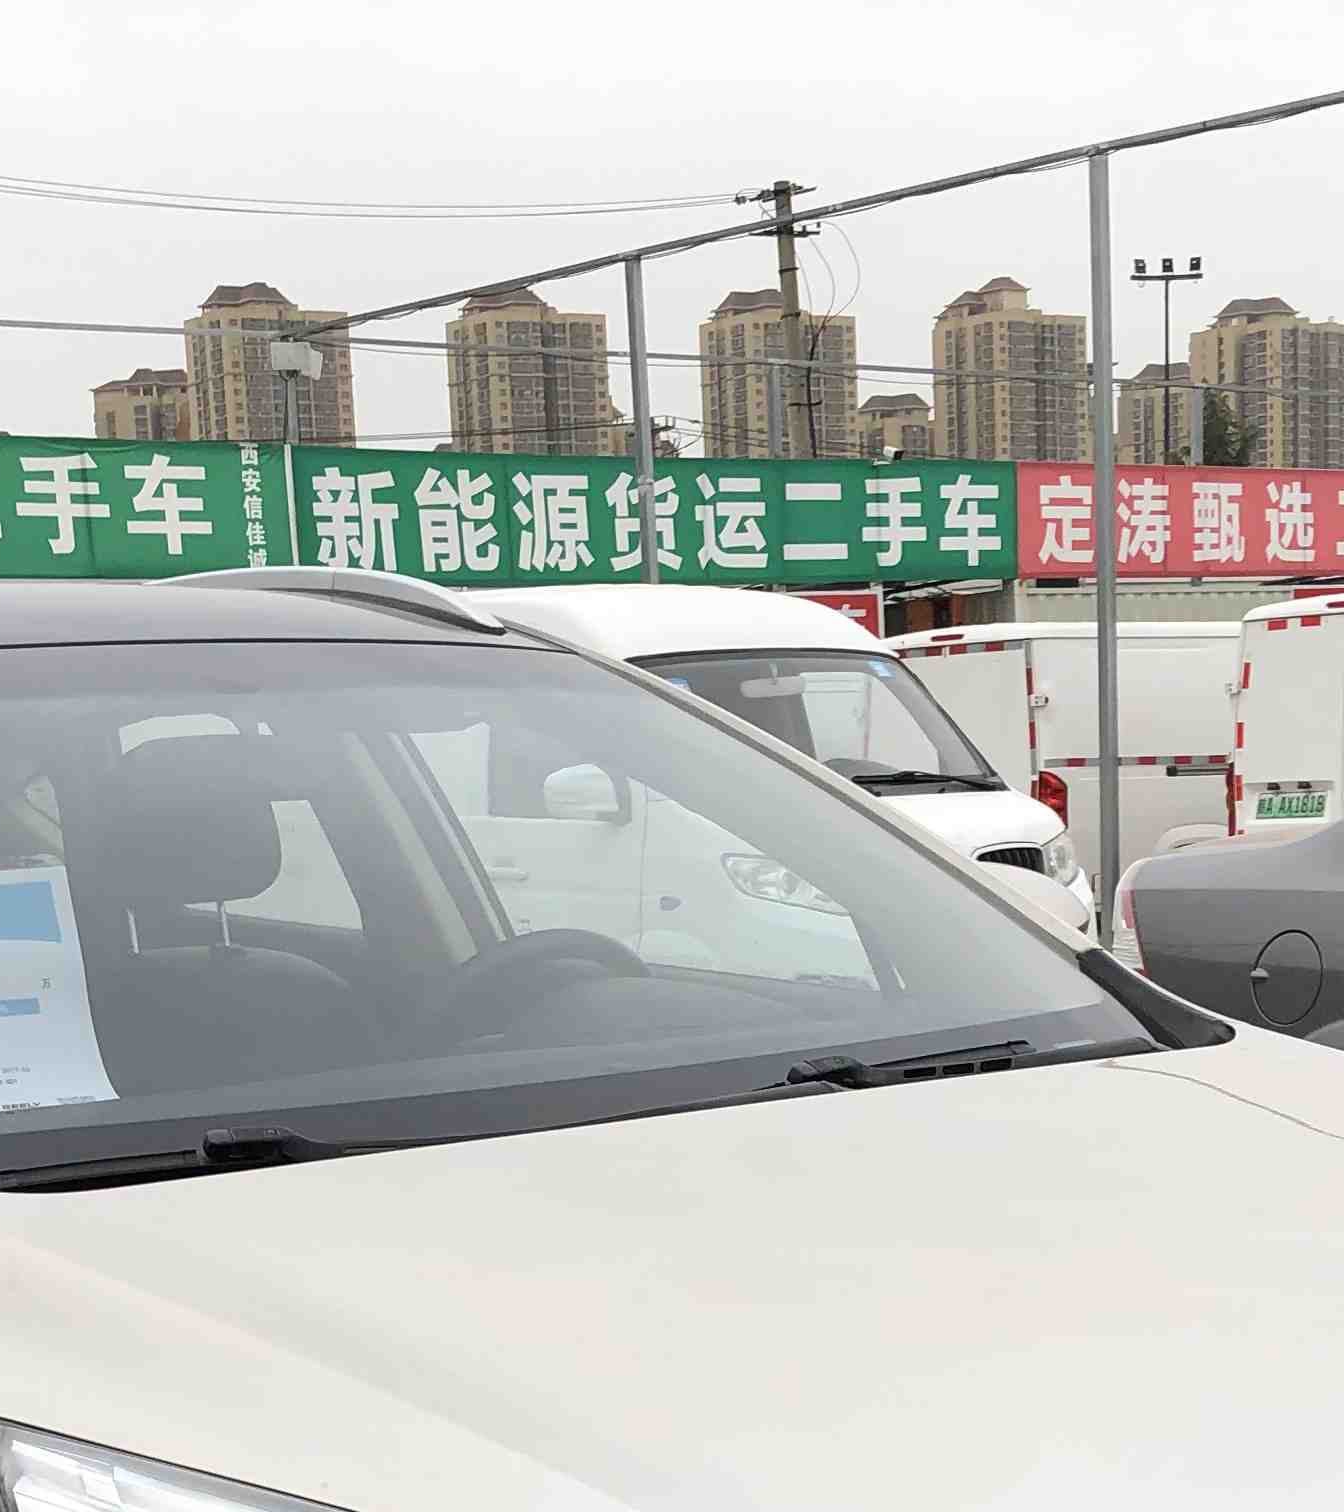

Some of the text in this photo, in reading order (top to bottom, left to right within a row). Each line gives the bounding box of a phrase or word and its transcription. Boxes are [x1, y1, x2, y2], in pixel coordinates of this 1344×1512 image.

[311, 466, 1002, 573] 新能源货运二手车
